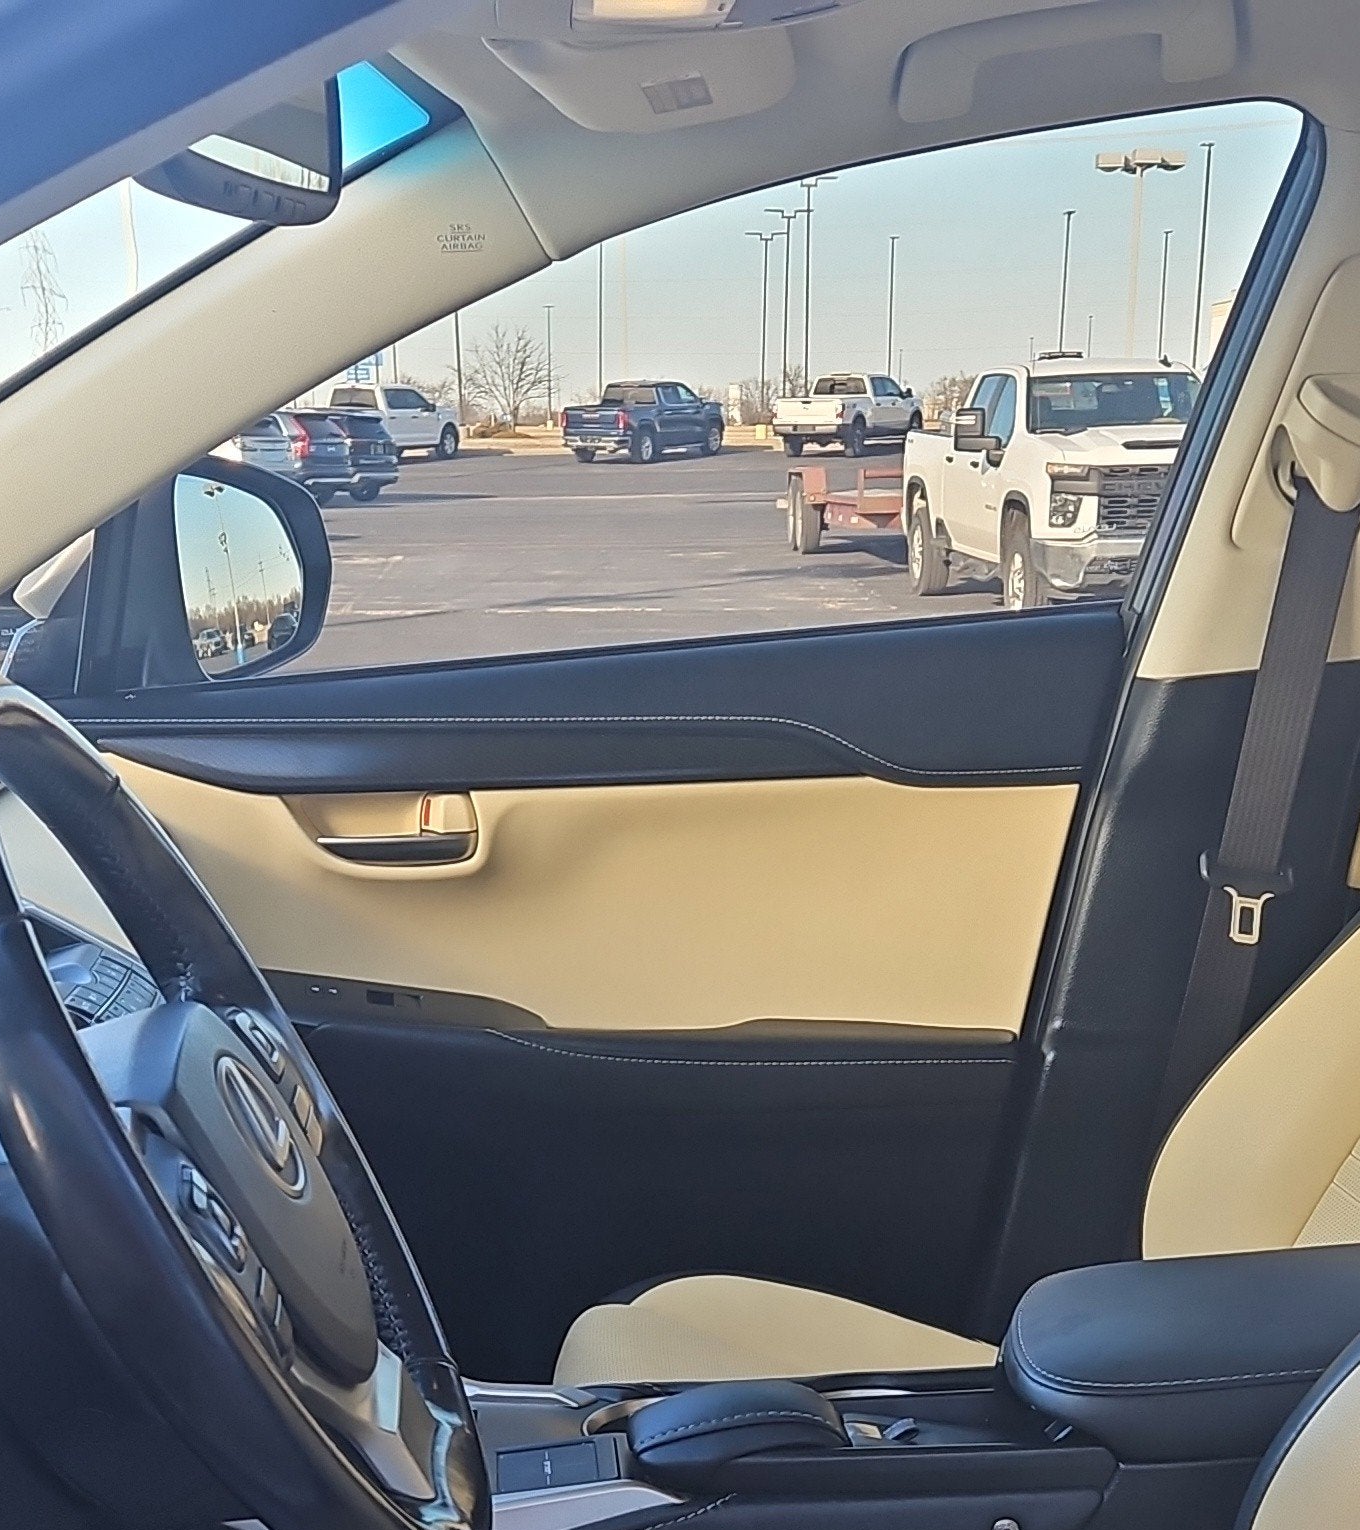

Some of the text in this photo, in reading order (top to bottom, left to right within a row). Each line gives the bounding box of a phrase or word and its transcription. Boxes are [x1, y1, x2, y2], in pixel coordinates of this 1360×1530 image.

[448, 223, 471, 231] SRS
[436, 233, 486, 242] CURTAIN
[441, 242, 483, 251] AIRBAG
